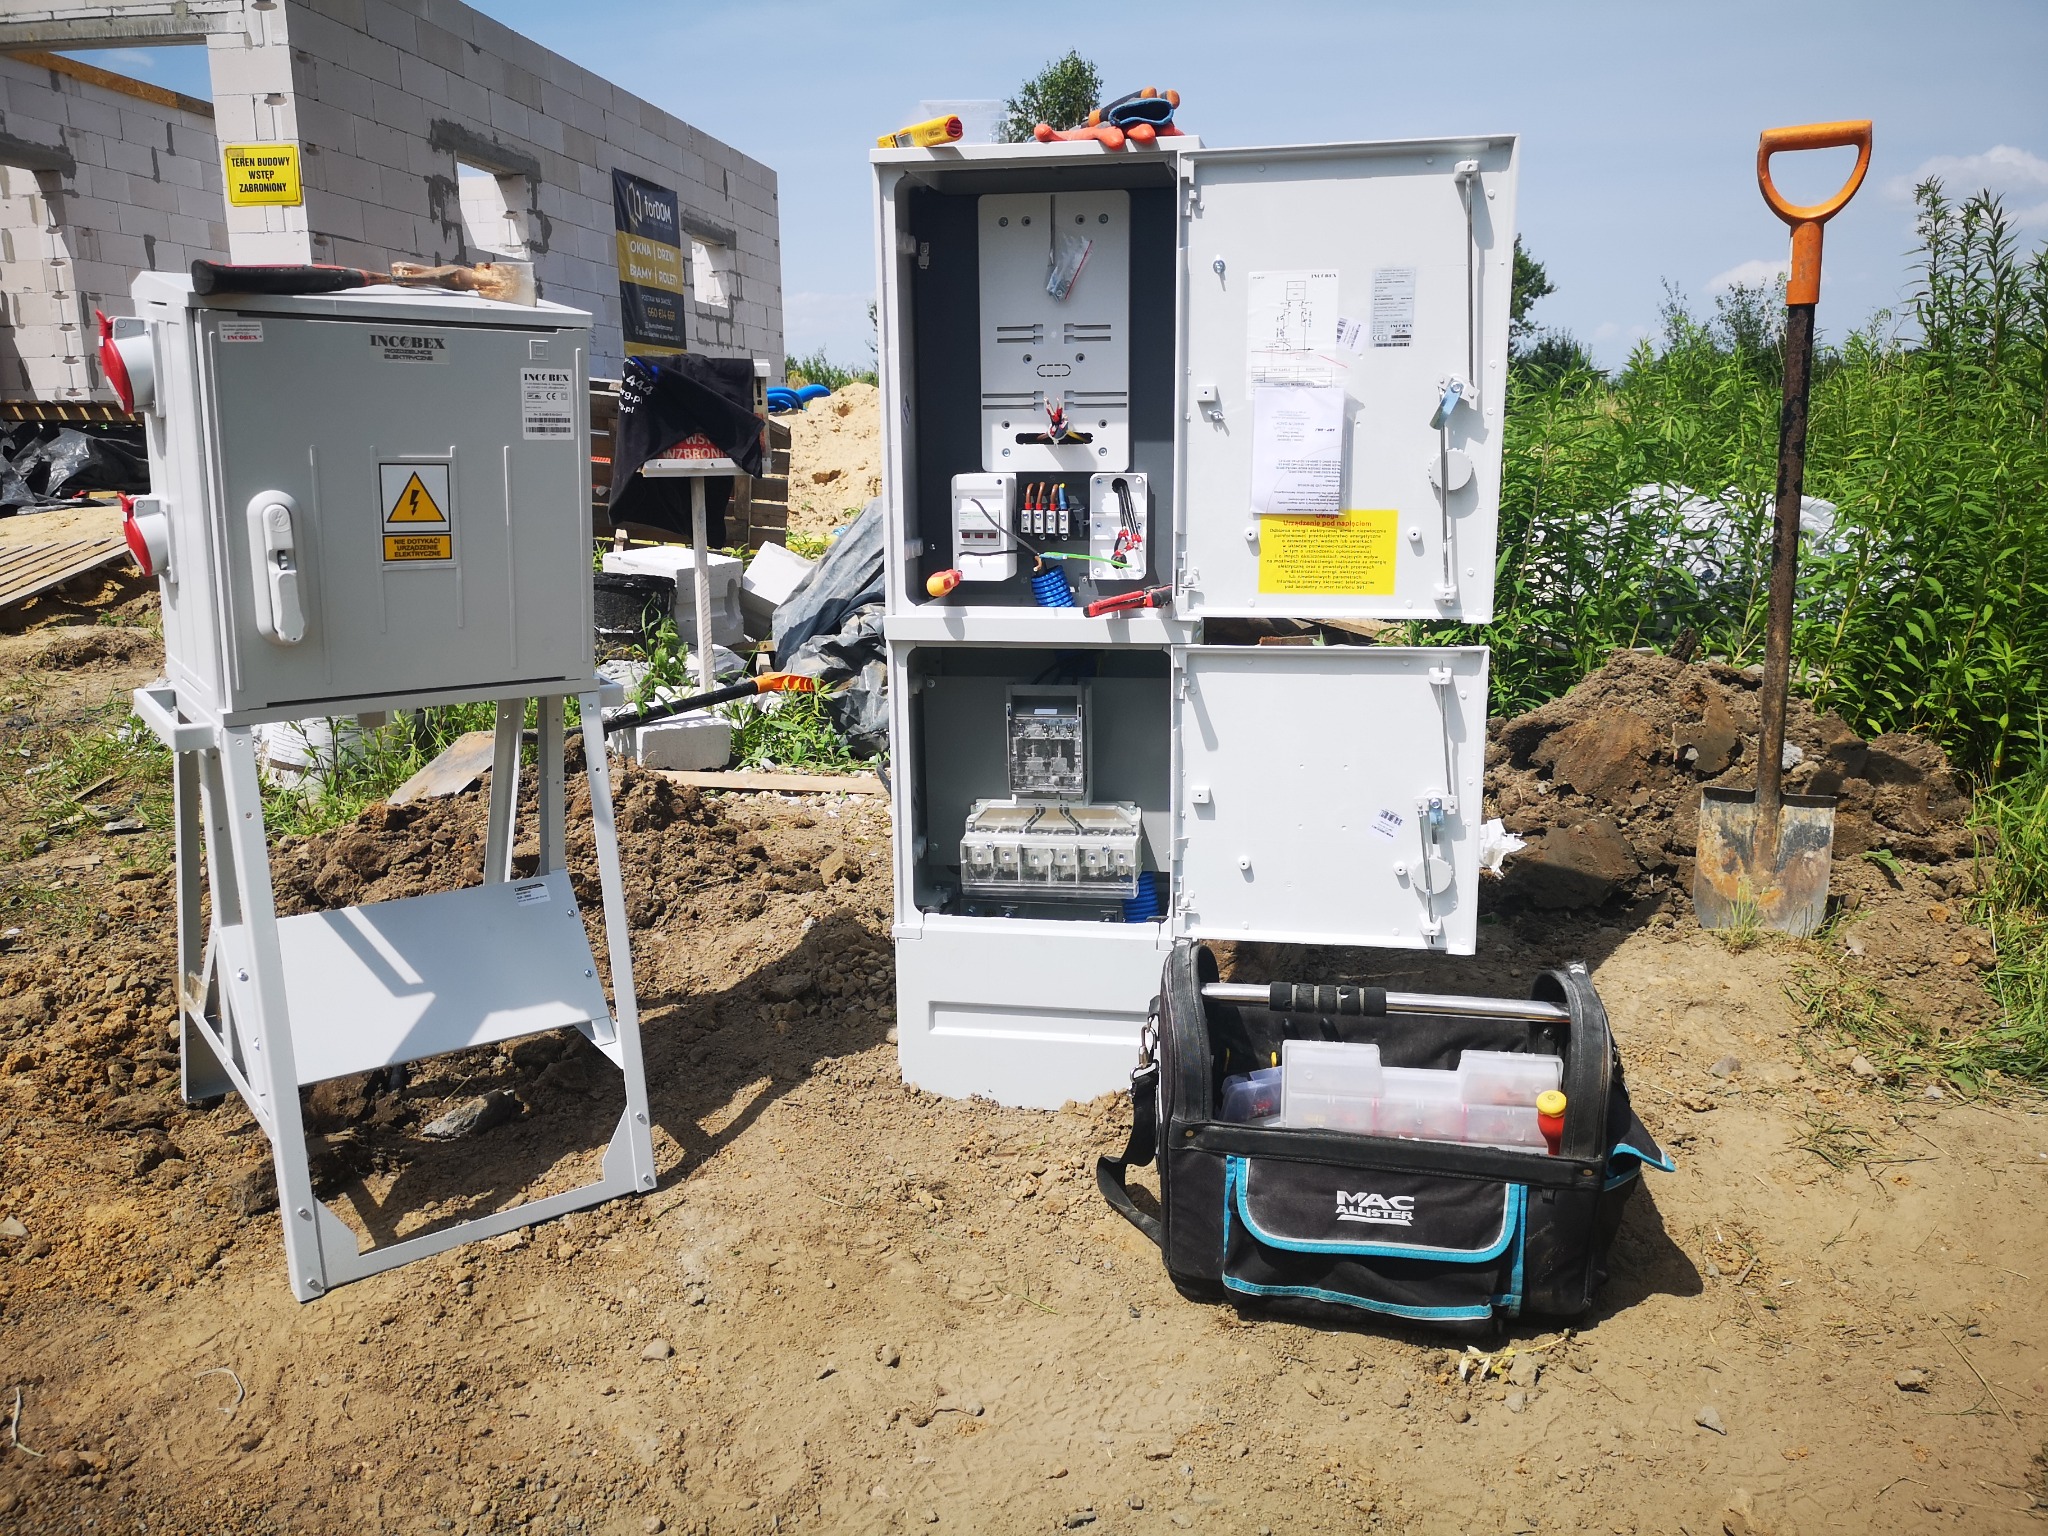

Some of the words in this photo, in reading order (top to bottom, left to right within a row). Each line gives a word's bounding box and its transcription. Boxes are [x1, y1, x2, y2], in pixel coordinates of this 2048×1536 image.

[232, 158, 255, 167] TEREN
[258, 157, 290, 166] BUDOWY
[248, 170, 274, 181] WSTĘP
[239, 183, 287, 192] ZABRONIONY
[644, 196, 672, 224] forDOM
[630, 241, 651, 256] OKNA
[630, 264, 652, 280] BRAMY
[370, 335, 445, 349] INCOBEX
[1337, 1190, 1414, 1210] MAC
[1335, 1205, 1414, 1220] ALLISTER
